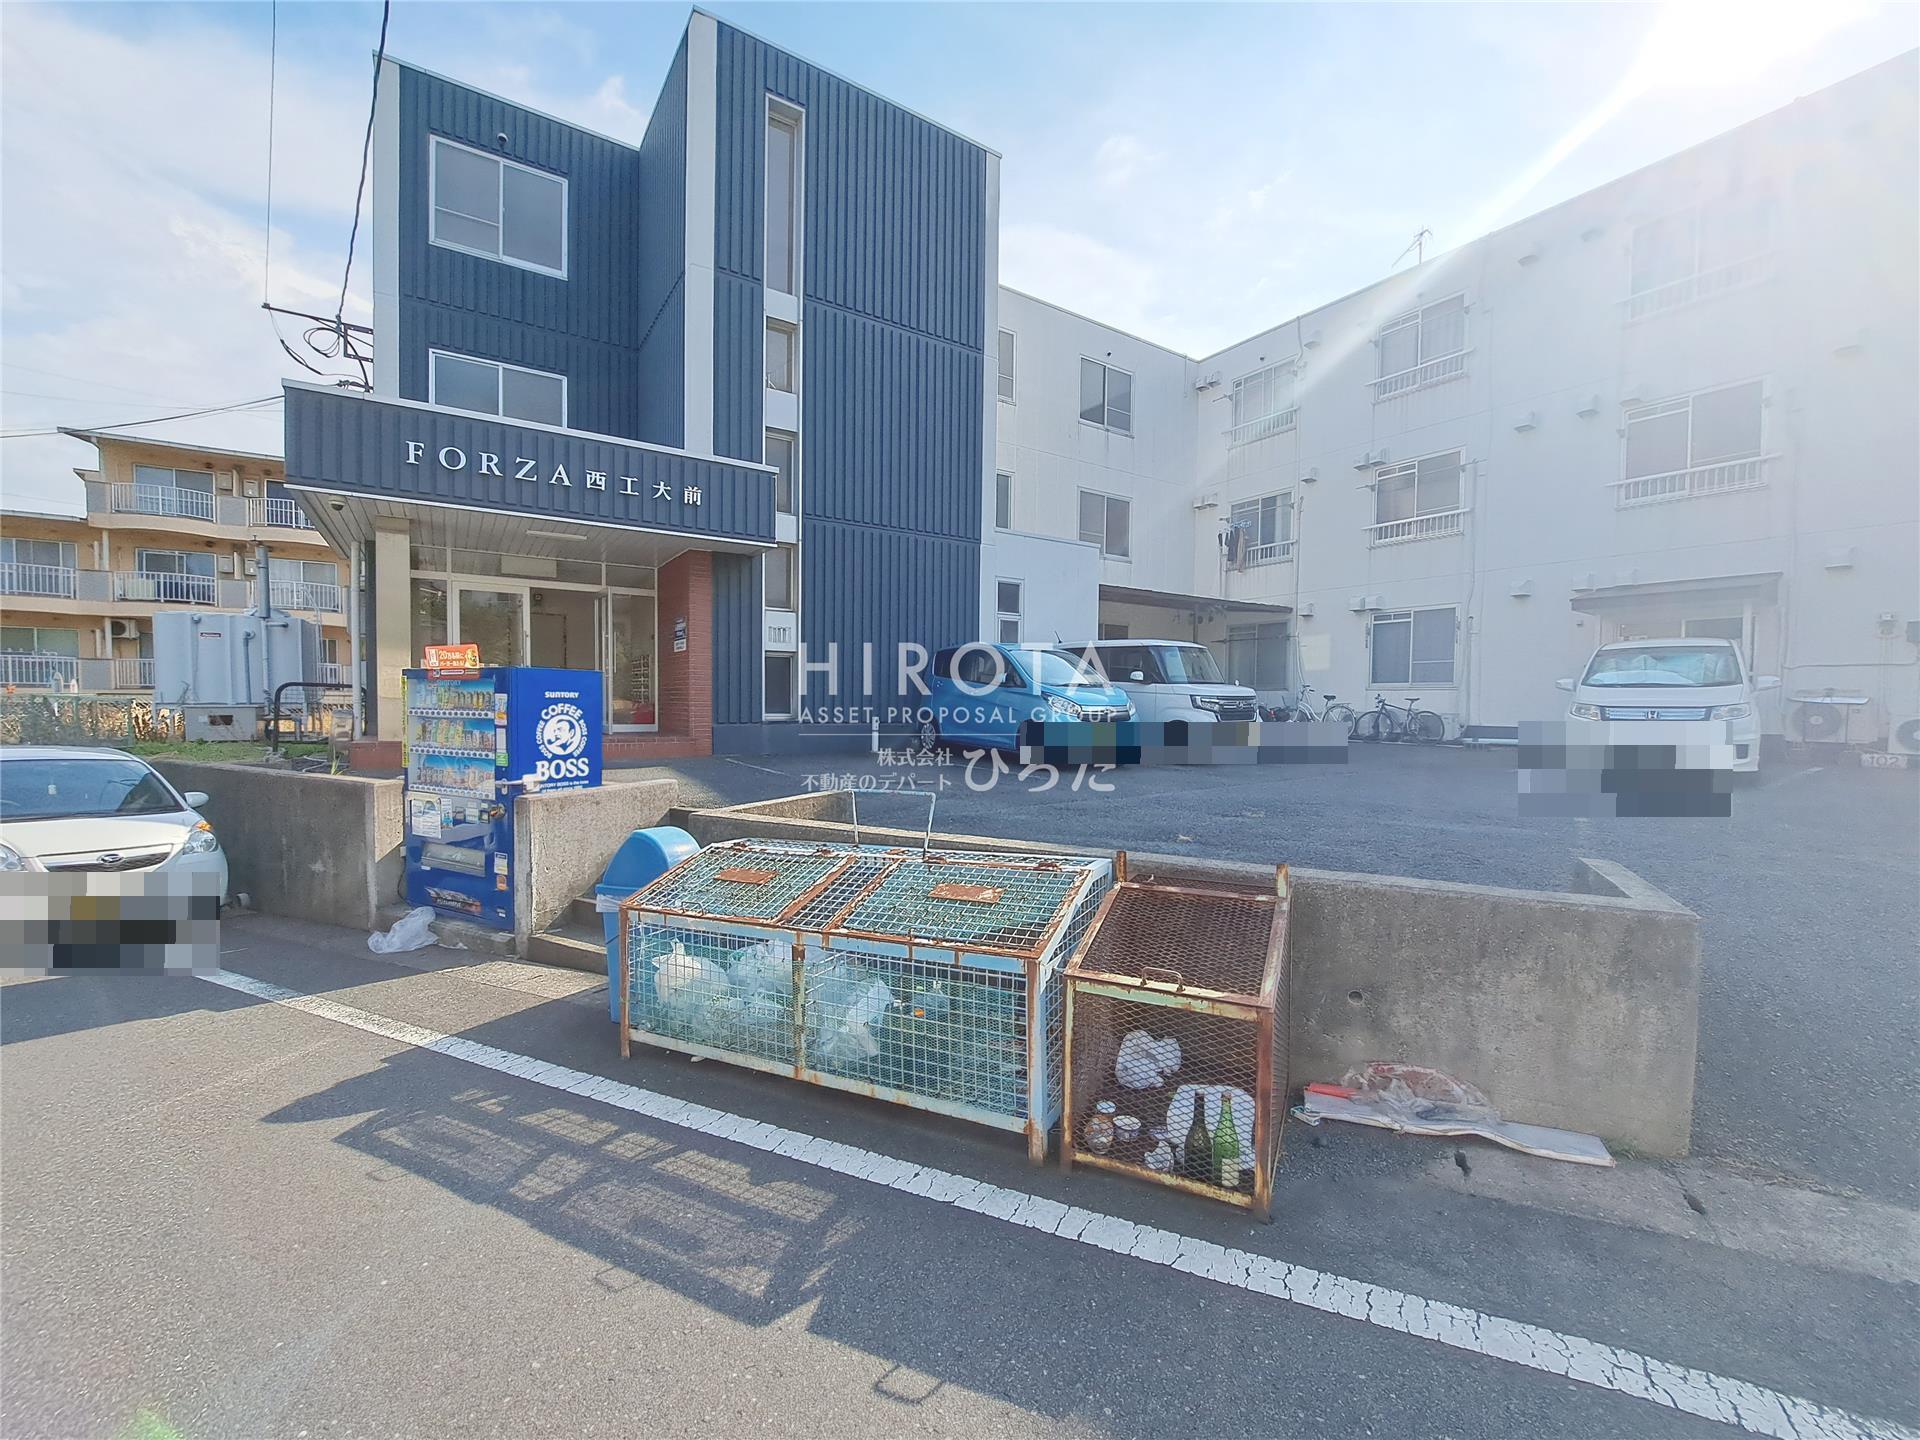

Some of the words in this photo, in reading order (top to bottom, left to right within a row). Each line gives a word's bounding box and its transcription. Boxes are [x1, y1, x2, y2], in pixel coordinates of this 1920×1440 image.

[405, 440, 572, 487] FORZA
[586, 469, 703, 506] 西工大前
[541, 703, 583, 720] COFFEE
[536, 757, 590, 780] BOSS
